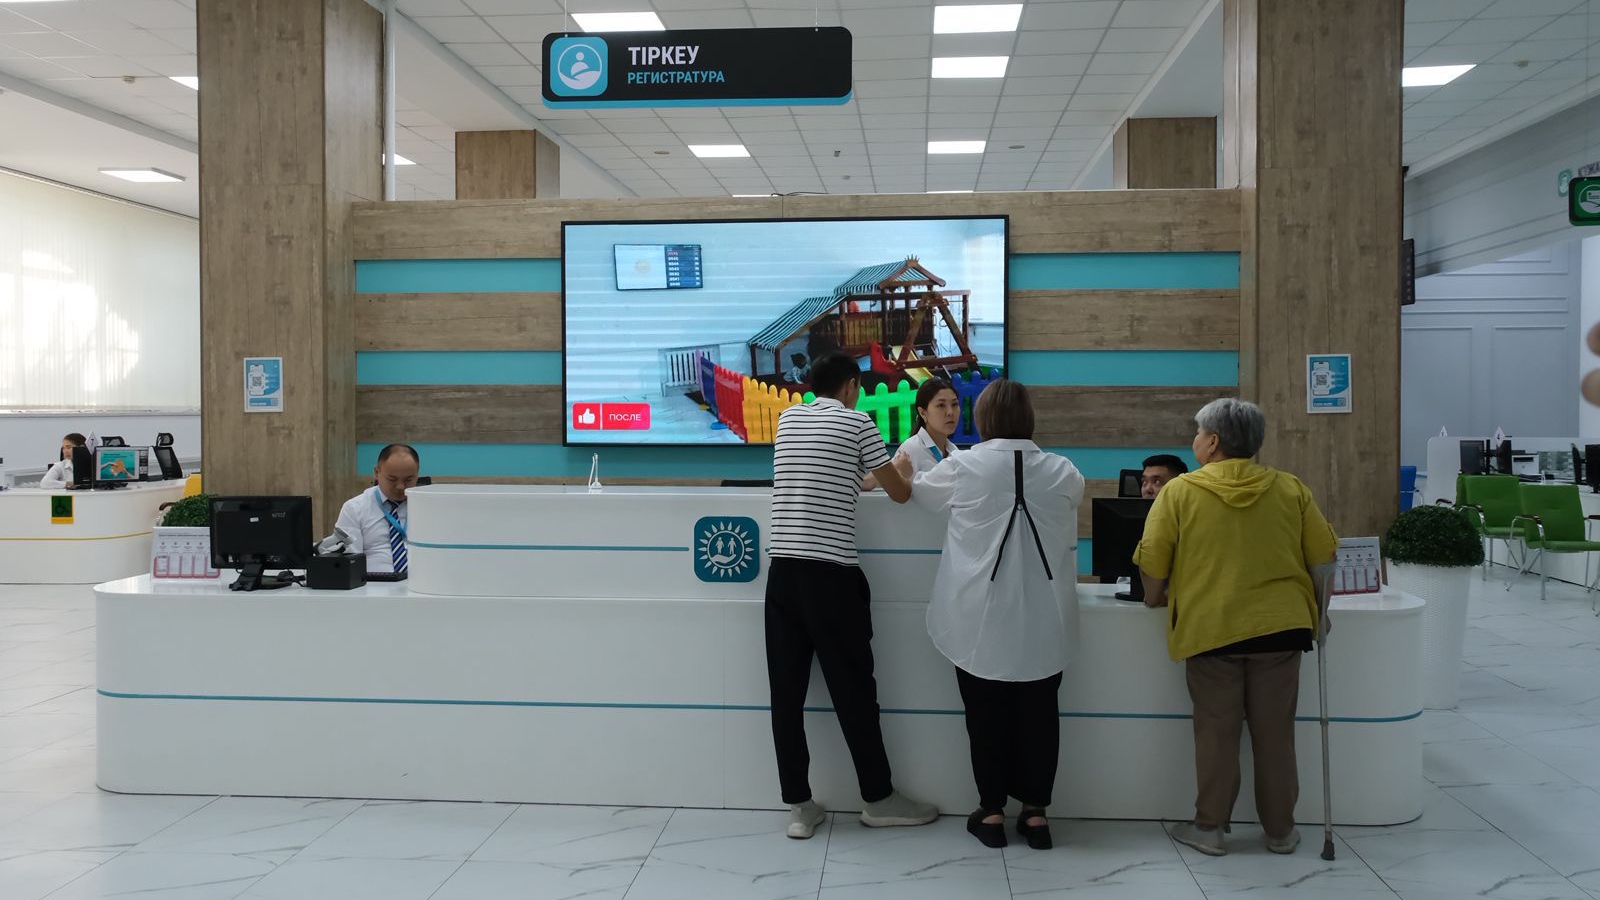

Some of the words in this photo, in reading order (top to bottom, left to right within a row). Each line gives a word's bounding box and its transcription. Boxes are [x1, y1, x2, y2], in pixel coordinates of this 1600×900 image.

[628, 45, 700, 66] ТІРКЕУ
[627, 70, 725, 84] РЕГИСТРАТУРА
[609, 413, 641, 421] ПОСЛЕ
